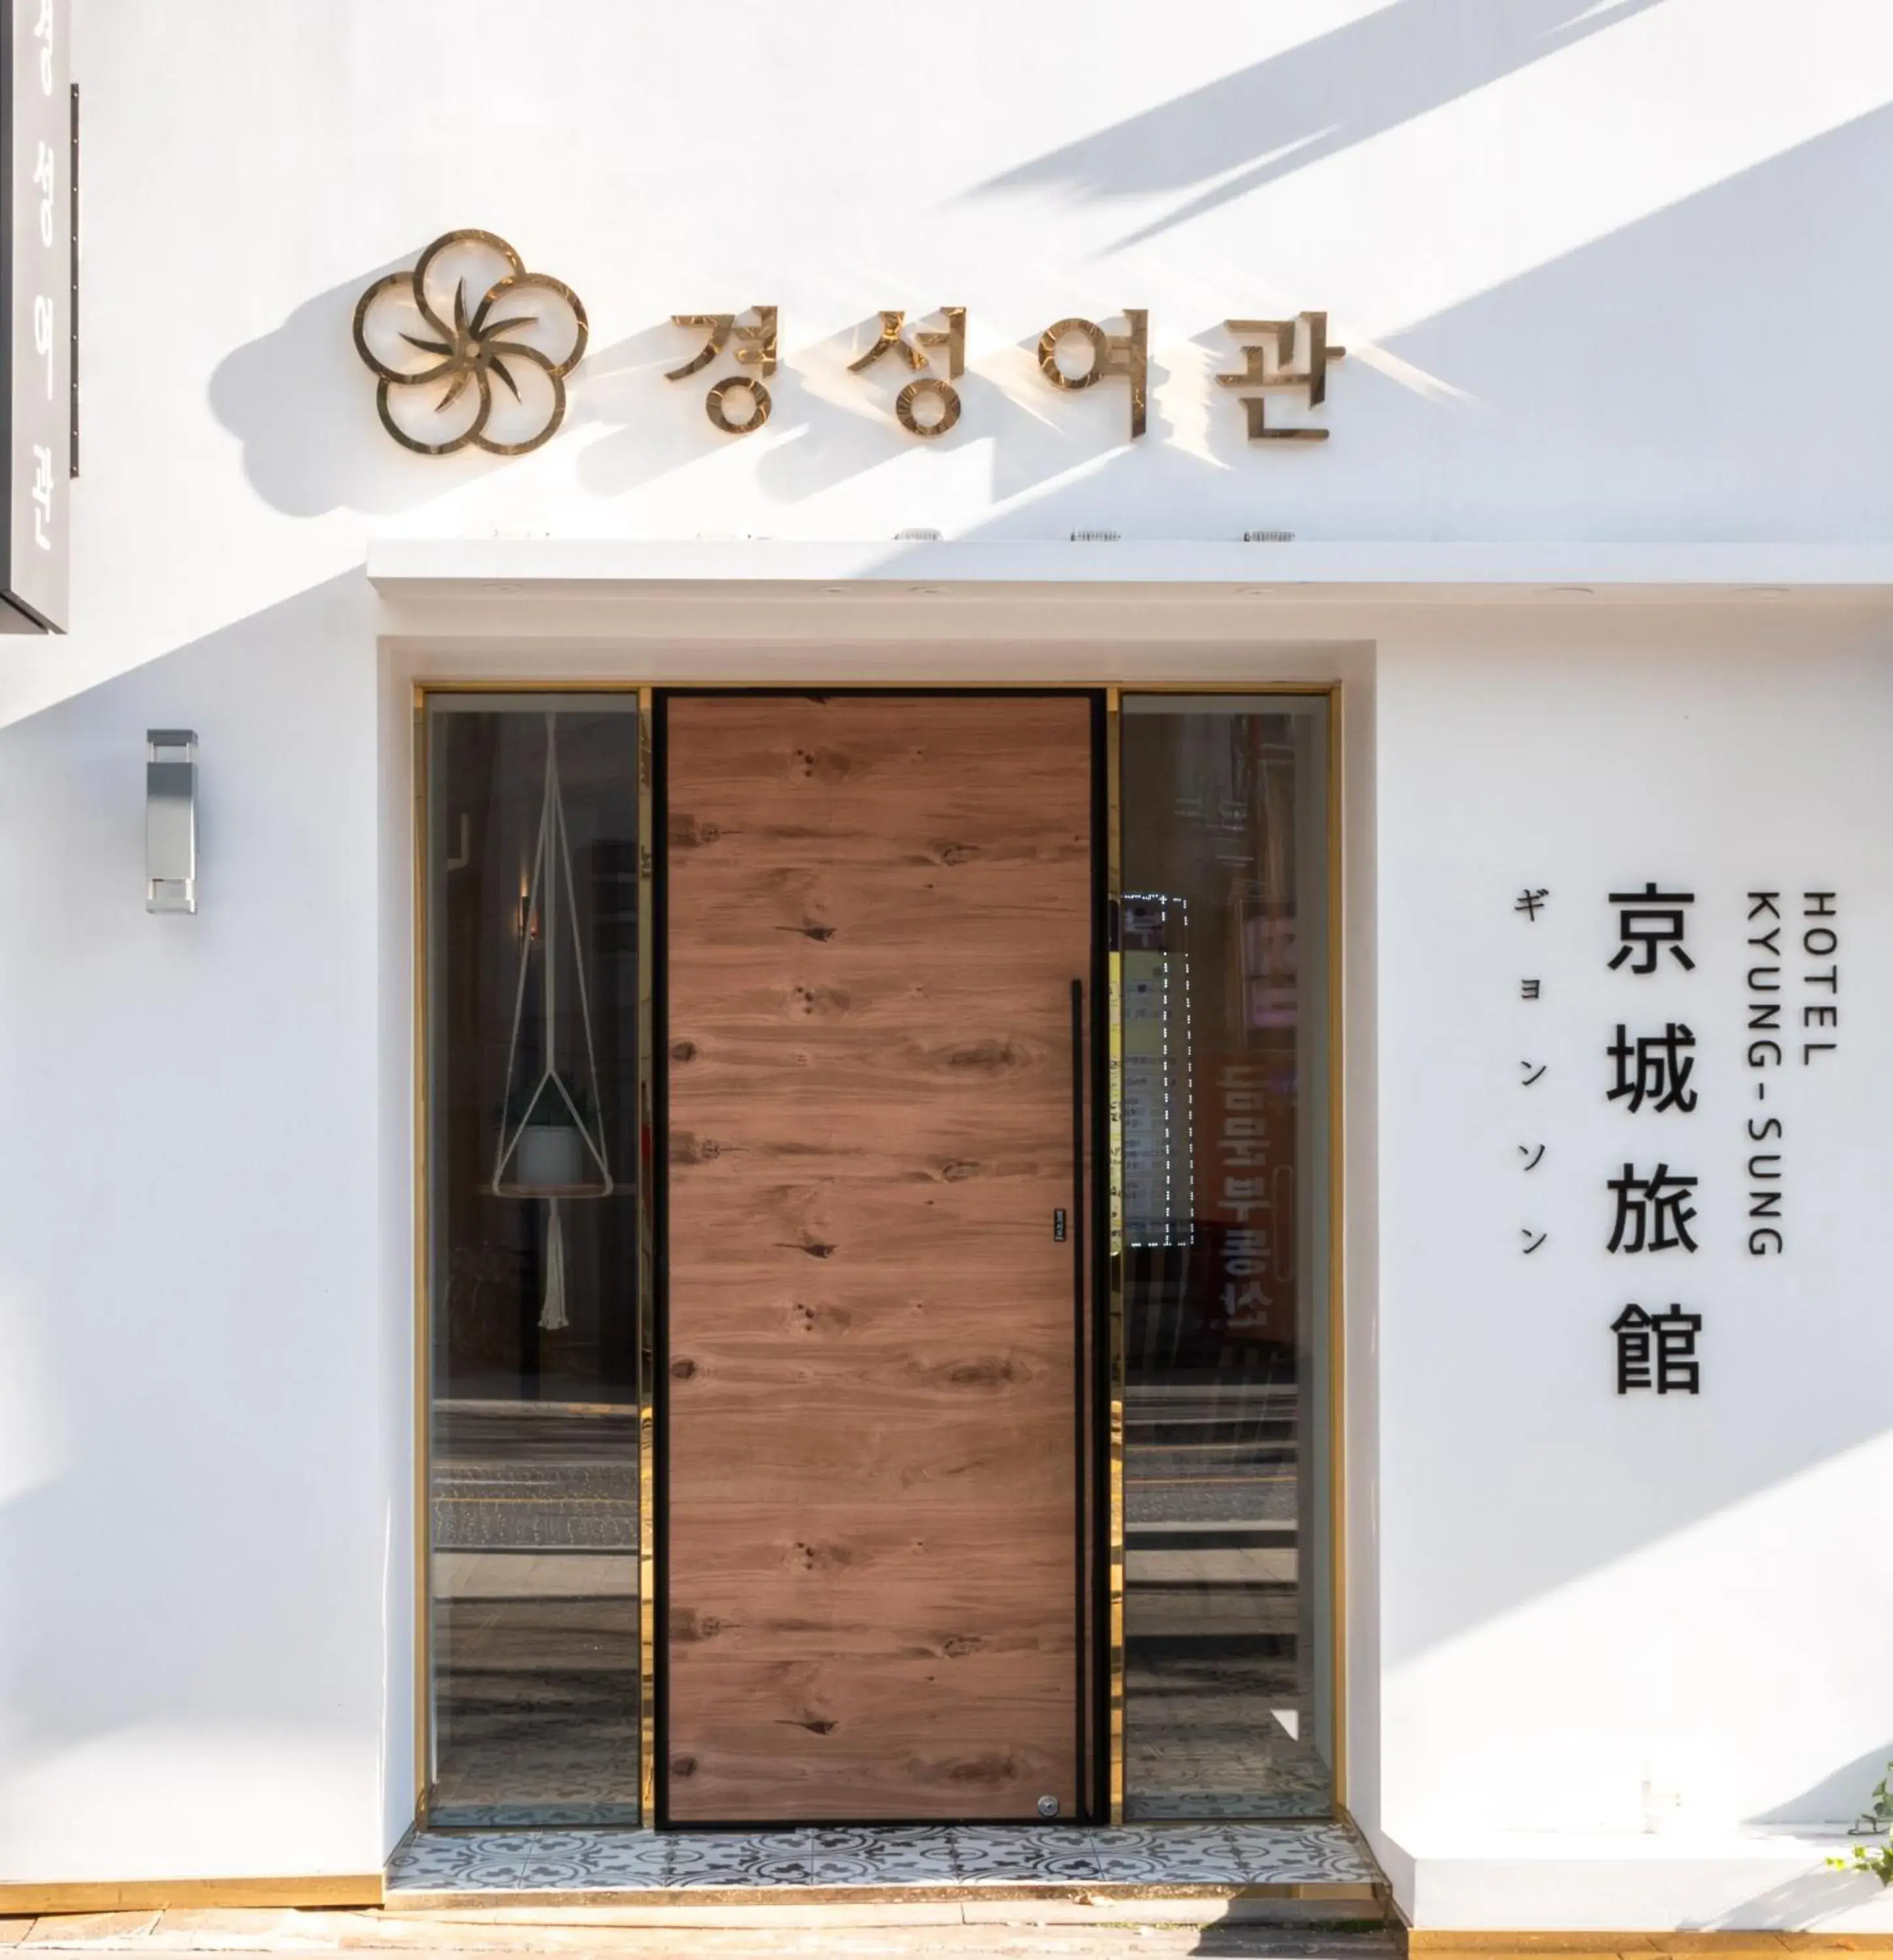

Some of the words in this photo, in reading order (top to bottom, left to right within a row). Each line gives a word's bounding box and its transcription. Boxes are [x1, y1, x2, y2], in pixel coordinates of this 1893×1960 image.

[663, 305, 1347, 442] 경성여관
[1747, 892, 1783, 1256] KYUNG-SUNG
[1803, 892, 1838, 1066] HOTEL
[1607, 883, 1702, 1394] 京城旅館
